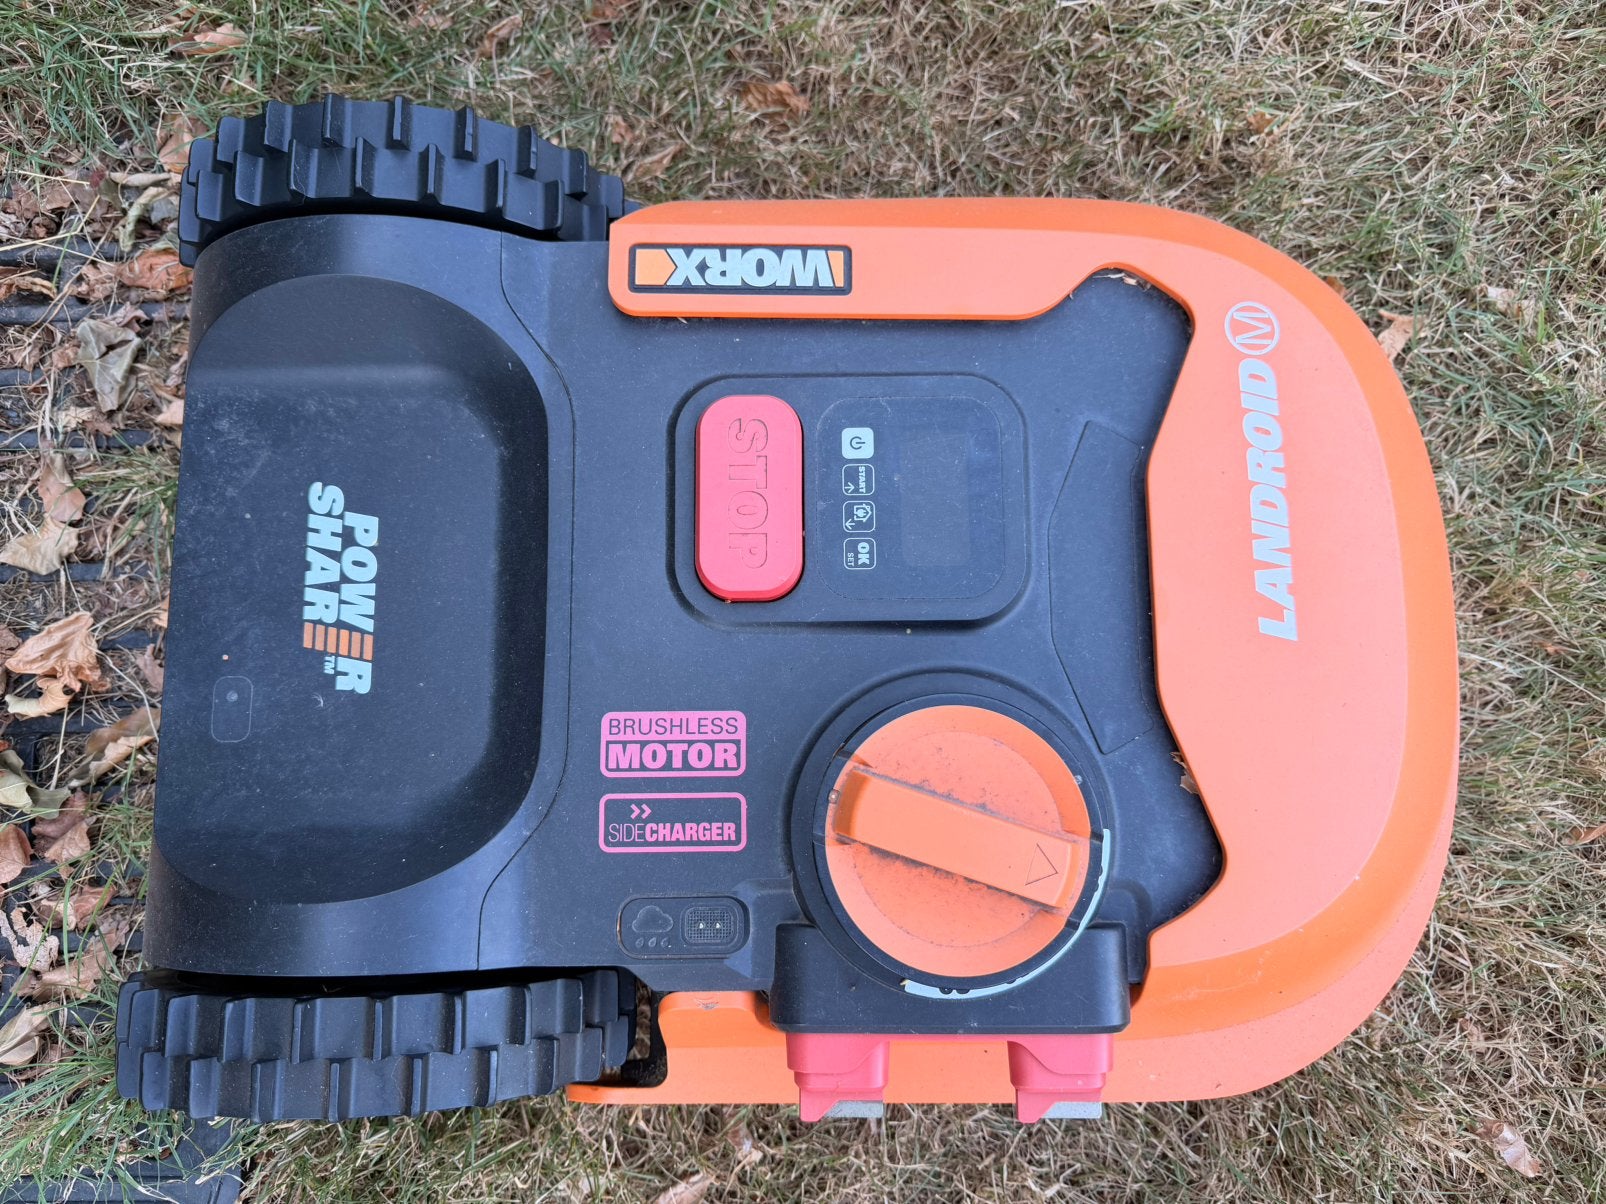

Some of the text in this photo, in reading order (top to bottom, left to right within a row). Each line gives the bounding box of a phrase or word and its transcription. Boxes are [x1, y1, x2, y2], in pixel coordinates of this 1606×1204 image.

[665, 247, 834, 288] WORX
[727, 417, 768, 569] STOP
[858, 466, 866, 493] START
[1237, 358, 1298, 641] LANDROID
[858, 542, 870, 564] OK
[335, 511, 379, 695] POWER
[608, 717, 738, 736] BRUSHLESS
[607, 743, 738, 769] MOTOR
[608, 822, 736, 842] SIDECHARGER
